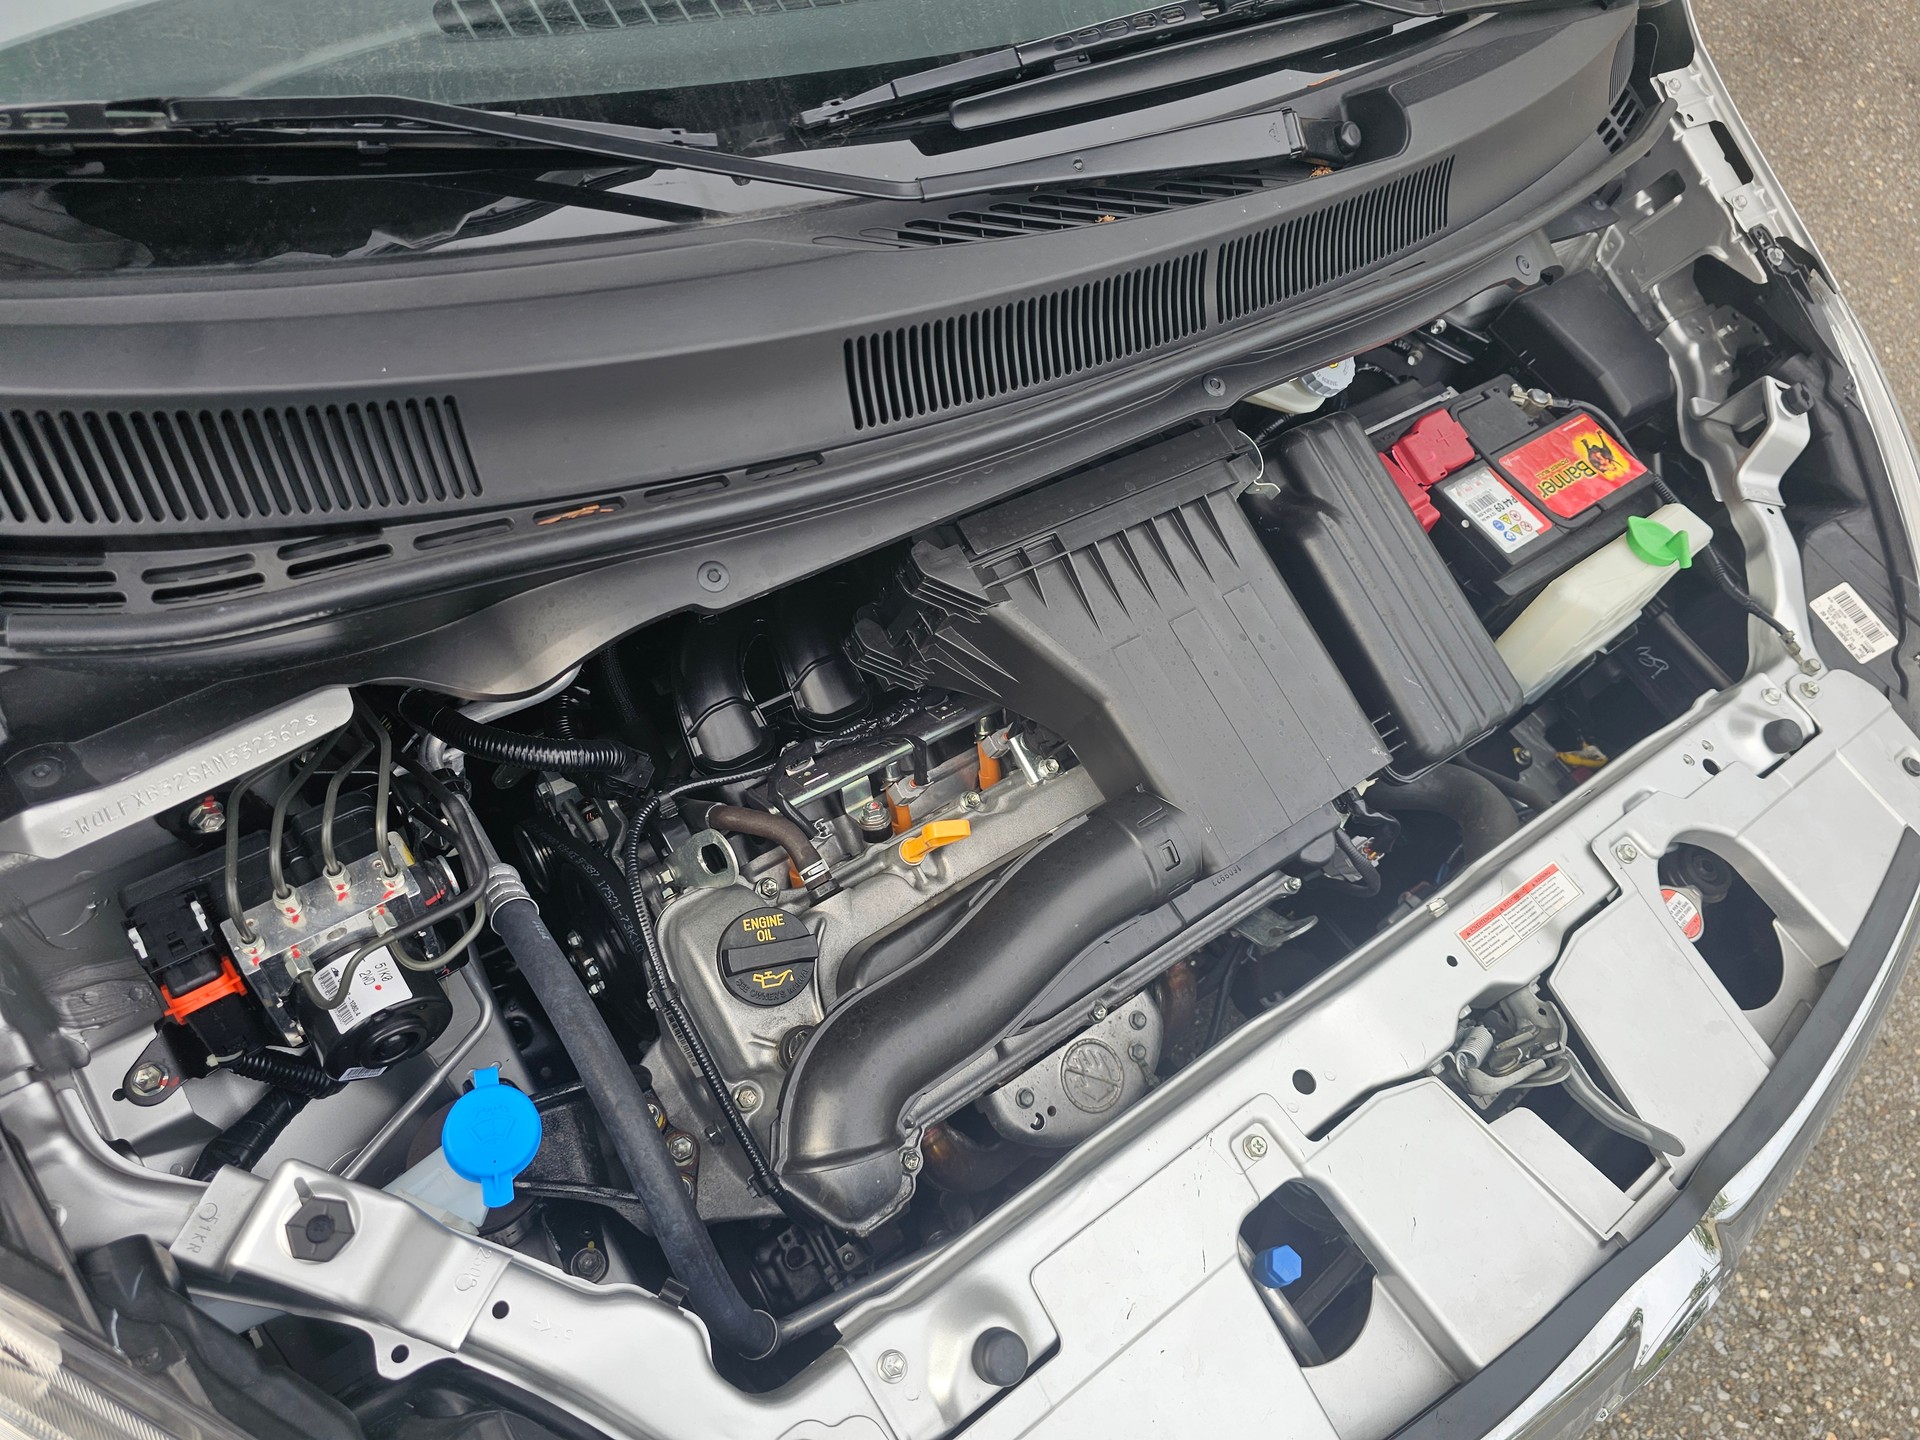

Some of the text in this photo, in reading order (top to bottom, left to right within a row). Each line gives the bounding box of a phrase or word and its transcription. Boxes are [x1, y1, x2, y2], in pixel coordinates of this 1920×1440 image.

[1539, 460, 1596, 499] Banner
[1492, 501, 1504, 513] 09
[1501, 493, 1517, 509] P44
[743, 914, 785, 931] ENGINE
[1470, 913, 1495, 932] ADVERTENCIA
[757, 930, 776, 941] OIL
[360, 970, 375, 986] 2WD
[736, 978, 748, 993] SEE
[750, 991, 786, 1000] OWNER'S
